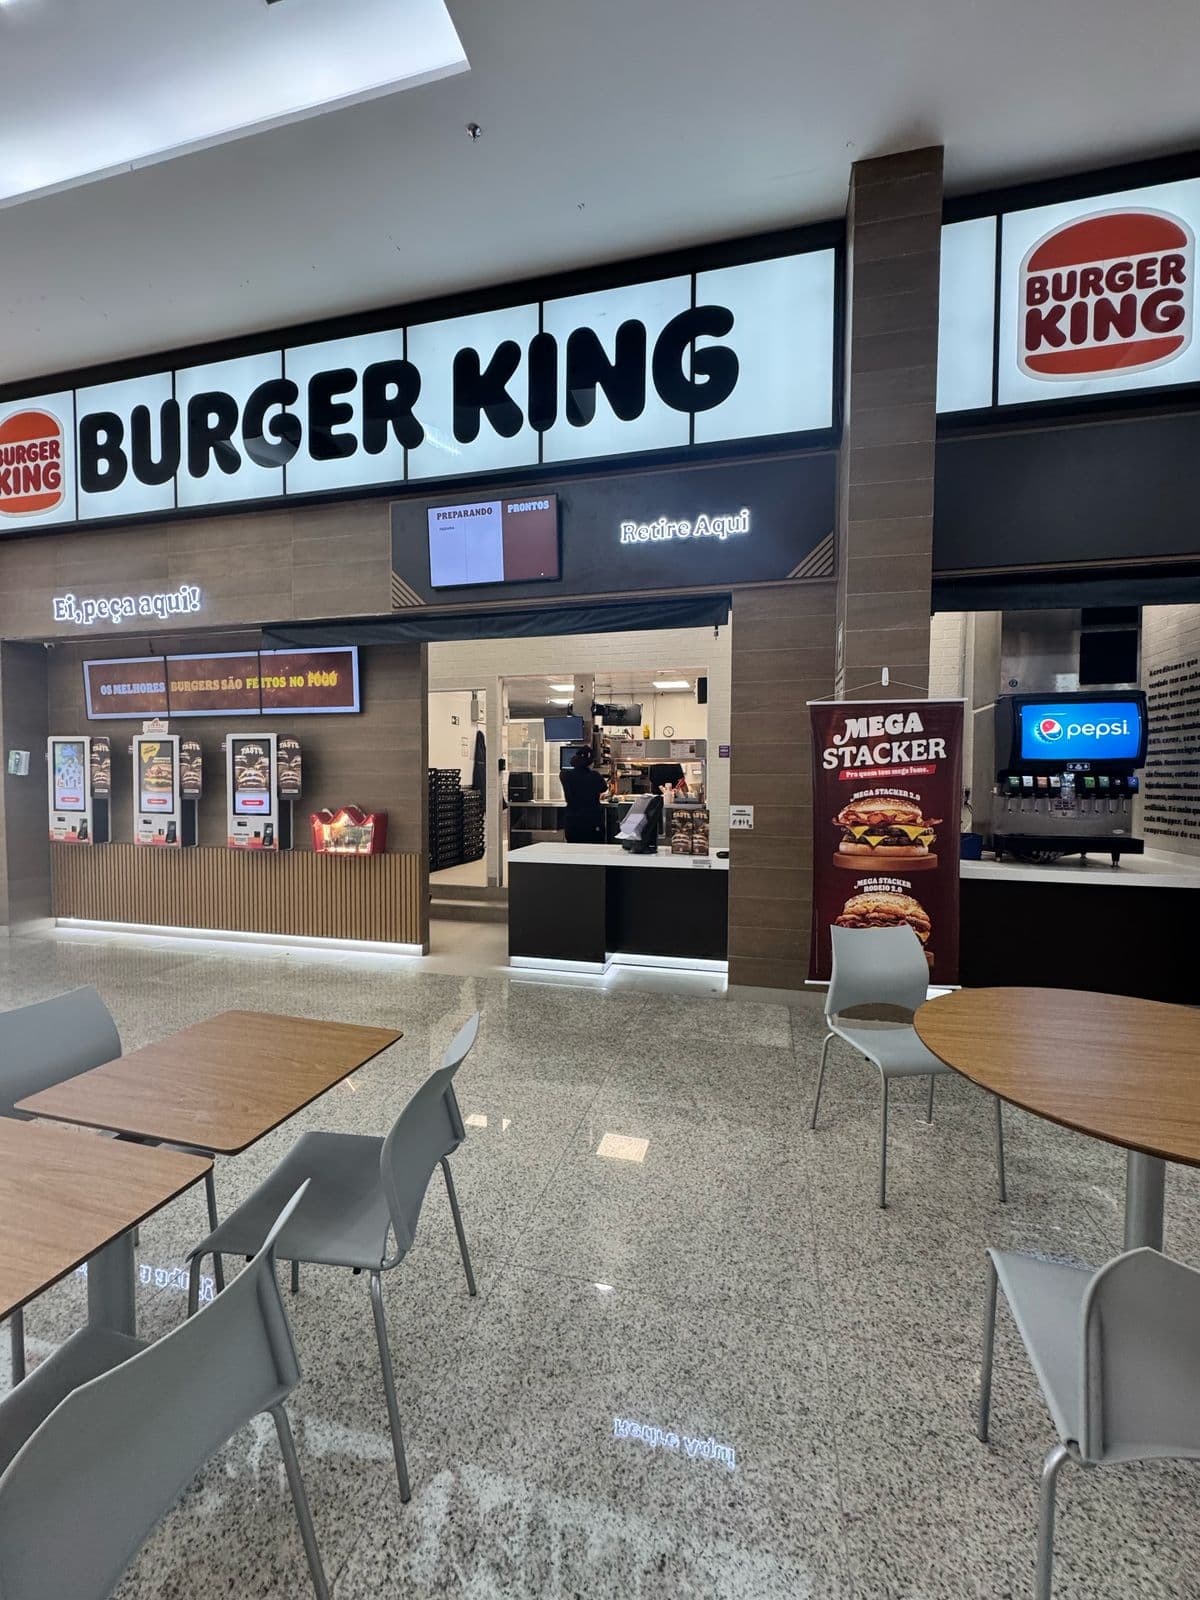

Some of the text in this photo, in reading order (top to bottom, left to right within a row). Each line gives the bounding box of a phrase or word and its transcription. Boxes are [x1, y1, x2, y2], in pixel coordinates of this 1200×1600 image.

[1026, 254, 1187, 306] BURGER
[1025, 288, 1185, 351] KING
[78, 305, 739, 493] BURGER KING
[0, 440, 61, 467] URGER
[436, 507, 493, 520] PREPARANDO
[507, 500, 550, 513] PRONTOS
[620, 508, 750, 543] Retire Aqui
[139, 585, 200, 618] aqui!
[100, 671, 338, 695] OS MELHORES BURGERS SÃO FEITOS NO FOGO
[833, 712, 924, 746] MEGA
[1067, 720, 1127, 740] pepsi
[822, 738, 947, 769] STACKER
[850, 788, 920, 802] MEGA STACKER 2.0
[854, 877, 911, 889] MEGA STACKER
